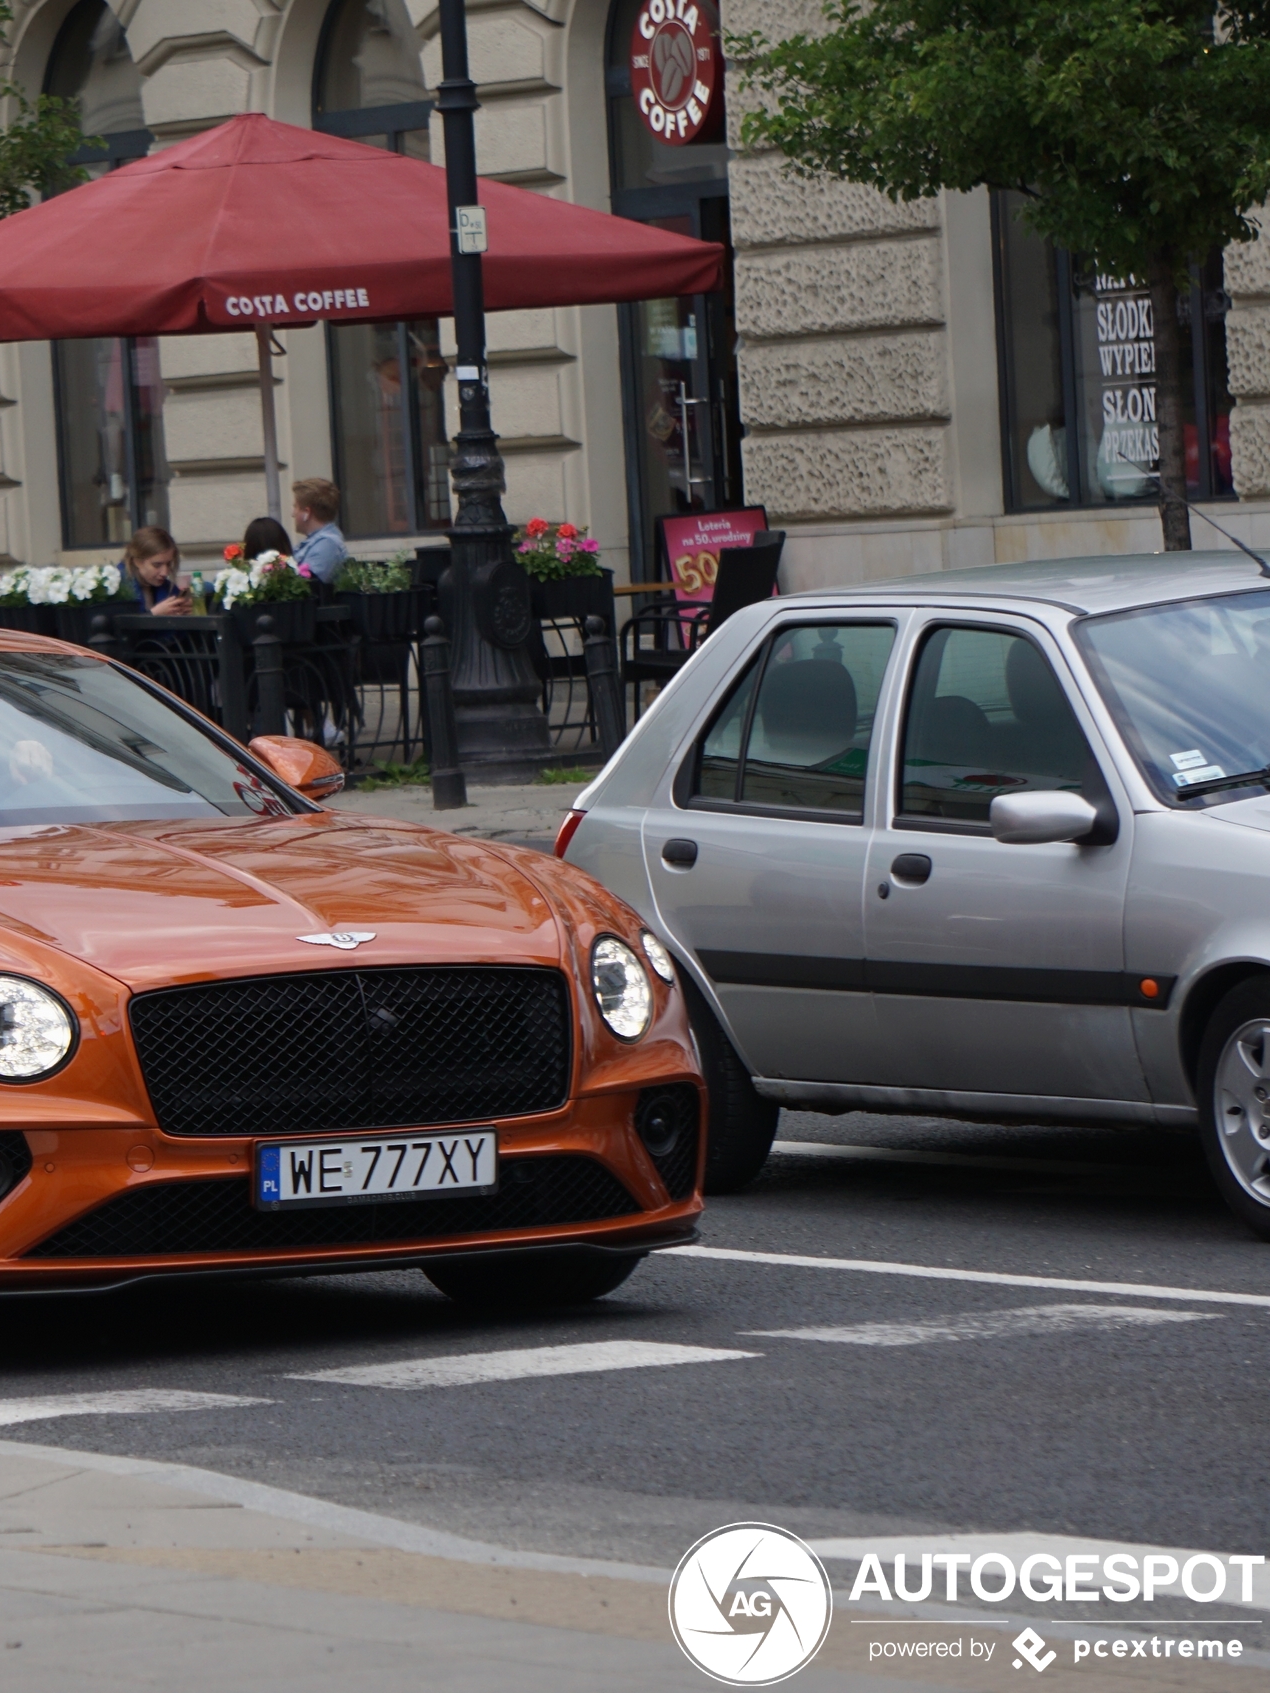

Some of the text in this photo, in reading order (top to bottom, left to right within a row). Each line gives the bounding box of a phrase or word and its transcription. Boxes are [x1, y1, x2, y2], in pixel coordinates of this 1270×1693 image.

[639, 0, 699, 39] COSTA
[639, 79, 710, 139] COFFEE
[224, 288, 370, 317] COSTA COFFEE
[1096, 299, 1154, 342] SŁODK
[682, 537, 693, 546] na
[698, 519, 731, 531] Loteria
[675, 550, 719, 595] 50
[290, 1138, 485, 1195] WE 777XY
[263, 1180, 278, 1193] PL
